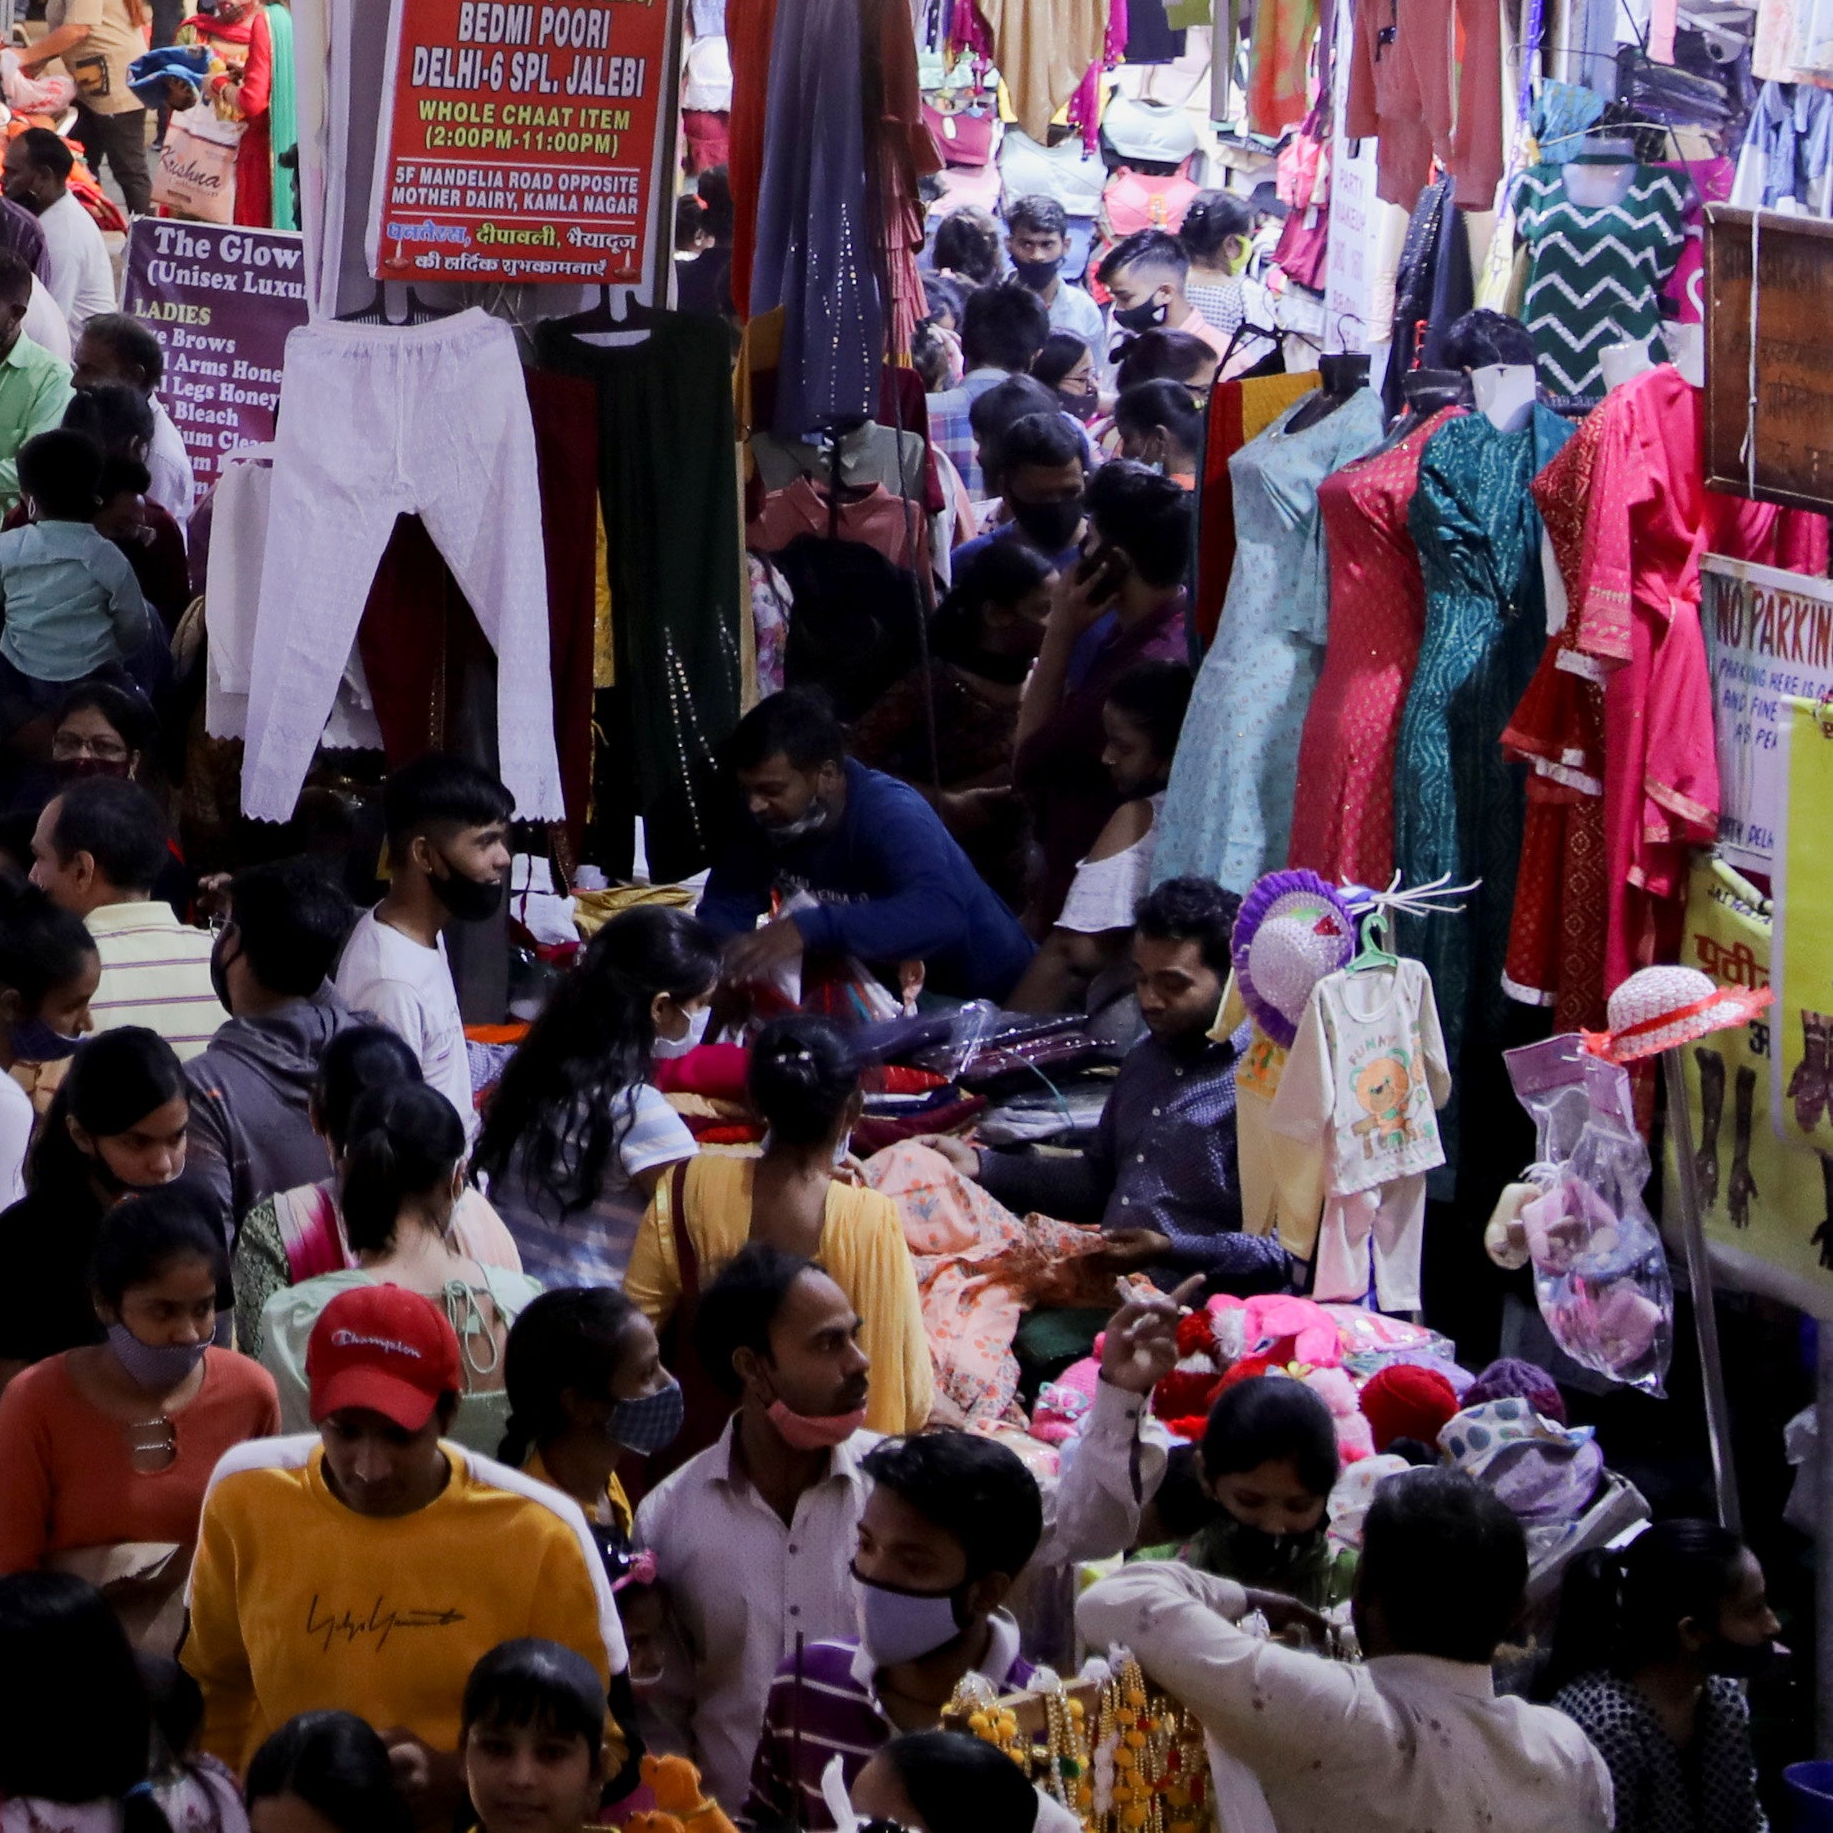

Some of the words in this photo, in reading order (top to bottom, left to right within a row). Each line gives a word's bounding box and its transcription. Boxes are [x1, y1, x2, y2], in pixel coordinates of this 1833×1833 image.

[458, 1, 533, 46] BEDMI
[538, 5, 611, 50] POORI
[412, 45, 505, 92] DELHI-6
[509, 51, 559, 94] SPL.
[565, 55, 646, 98] JALEBI
[419, 99, 495, 124] WHOLE
[502, 103, 573, 128] CHAAT
[579, 108, 630, 131] ITEM
[425, 124, 619, 159] (2:00PM-11:00PM)
[395, 166, 416, 184] 5F
[419, 167, 504, 189] MANDELIA
[509, 171, 553, 190] ROAD
[558, 173, 639, 194] OPPOSITE
[391, 186, 460, 207] MOTHER
[466, 189, 518, 213] DAIRY,
[523, 194, 578, 213] KAMLA
[583, 196, 638, 215] NAGAR
[154, 226, 212, 260] The
[219, 234, 302, 270] Glow
[147, 259, 238, 292] (Unisex
[134, 298, 211, 326] LADIES
[172, 328, 236, 354] Brows
[174, 353, 228, 378] Arms
[232, 360, 283, 383] Hone
[172, 376, 215, 403] Legs
[174, 400, 239, 427] Bleach
[1716, 581, 1744, 648] NO
[1749, 589, 1833, 670] PARKIN
[1769, 671, 1799, 695] HERE
[1722, 688, 1746, 713] AND
[1751, 696, 1778, 723] FINE
[332, 1329, 422, 1359] Champion
